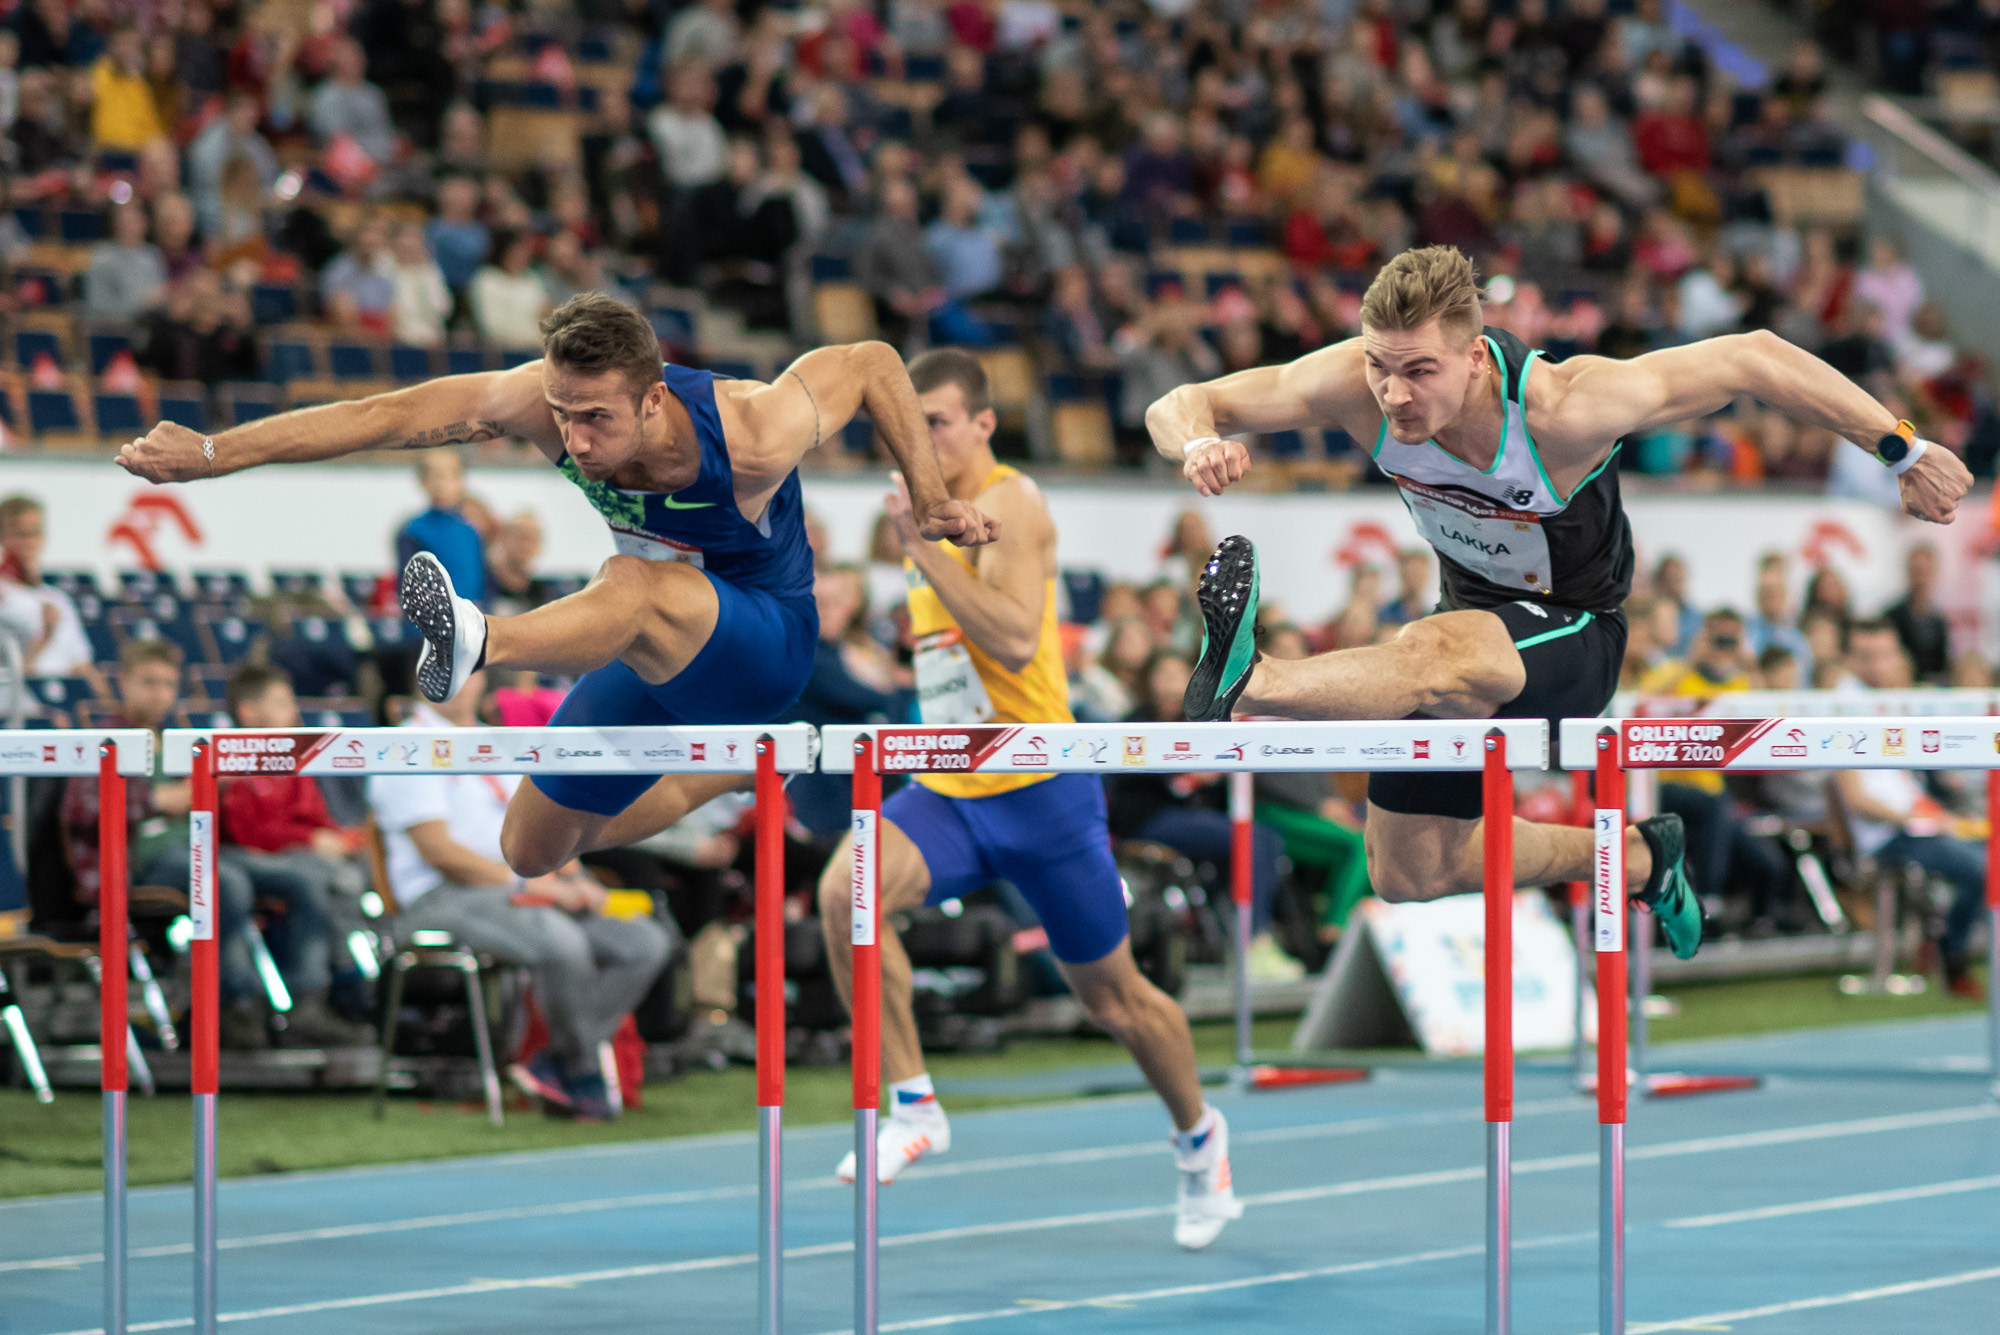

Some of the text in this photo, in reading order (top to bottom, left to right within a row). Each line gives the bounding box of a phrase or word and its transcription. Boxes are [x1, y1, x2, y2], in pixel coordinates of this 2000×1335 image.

[1445, 496, 1465, 507] CUP
[1499, 510, 1528, 520] 2020
[1440, 524, 1511, 556] LAKKA
[1628, 725, 1724, 741] ORLEN CUP
[218, 737, 296, 753] ORLEN CUP
[884, 734, 971, 751] ORLEN CUP
[643, 749, 685, 757] NOVOTEL
[1274, 747, 1315, 755] LEXUS
[1360, 747, 1407, 755] NOVOTEL
[1681, 746, 1724, 761] 2020
[261, 756, 296, 771] 2020
[884, 751, 971, 770] ŁÓDŹ 2020
[192, 844, 206, 908] polanik
[853, 843, 868, 911] polanik
[1597, 844, 1615, 915] polanik
